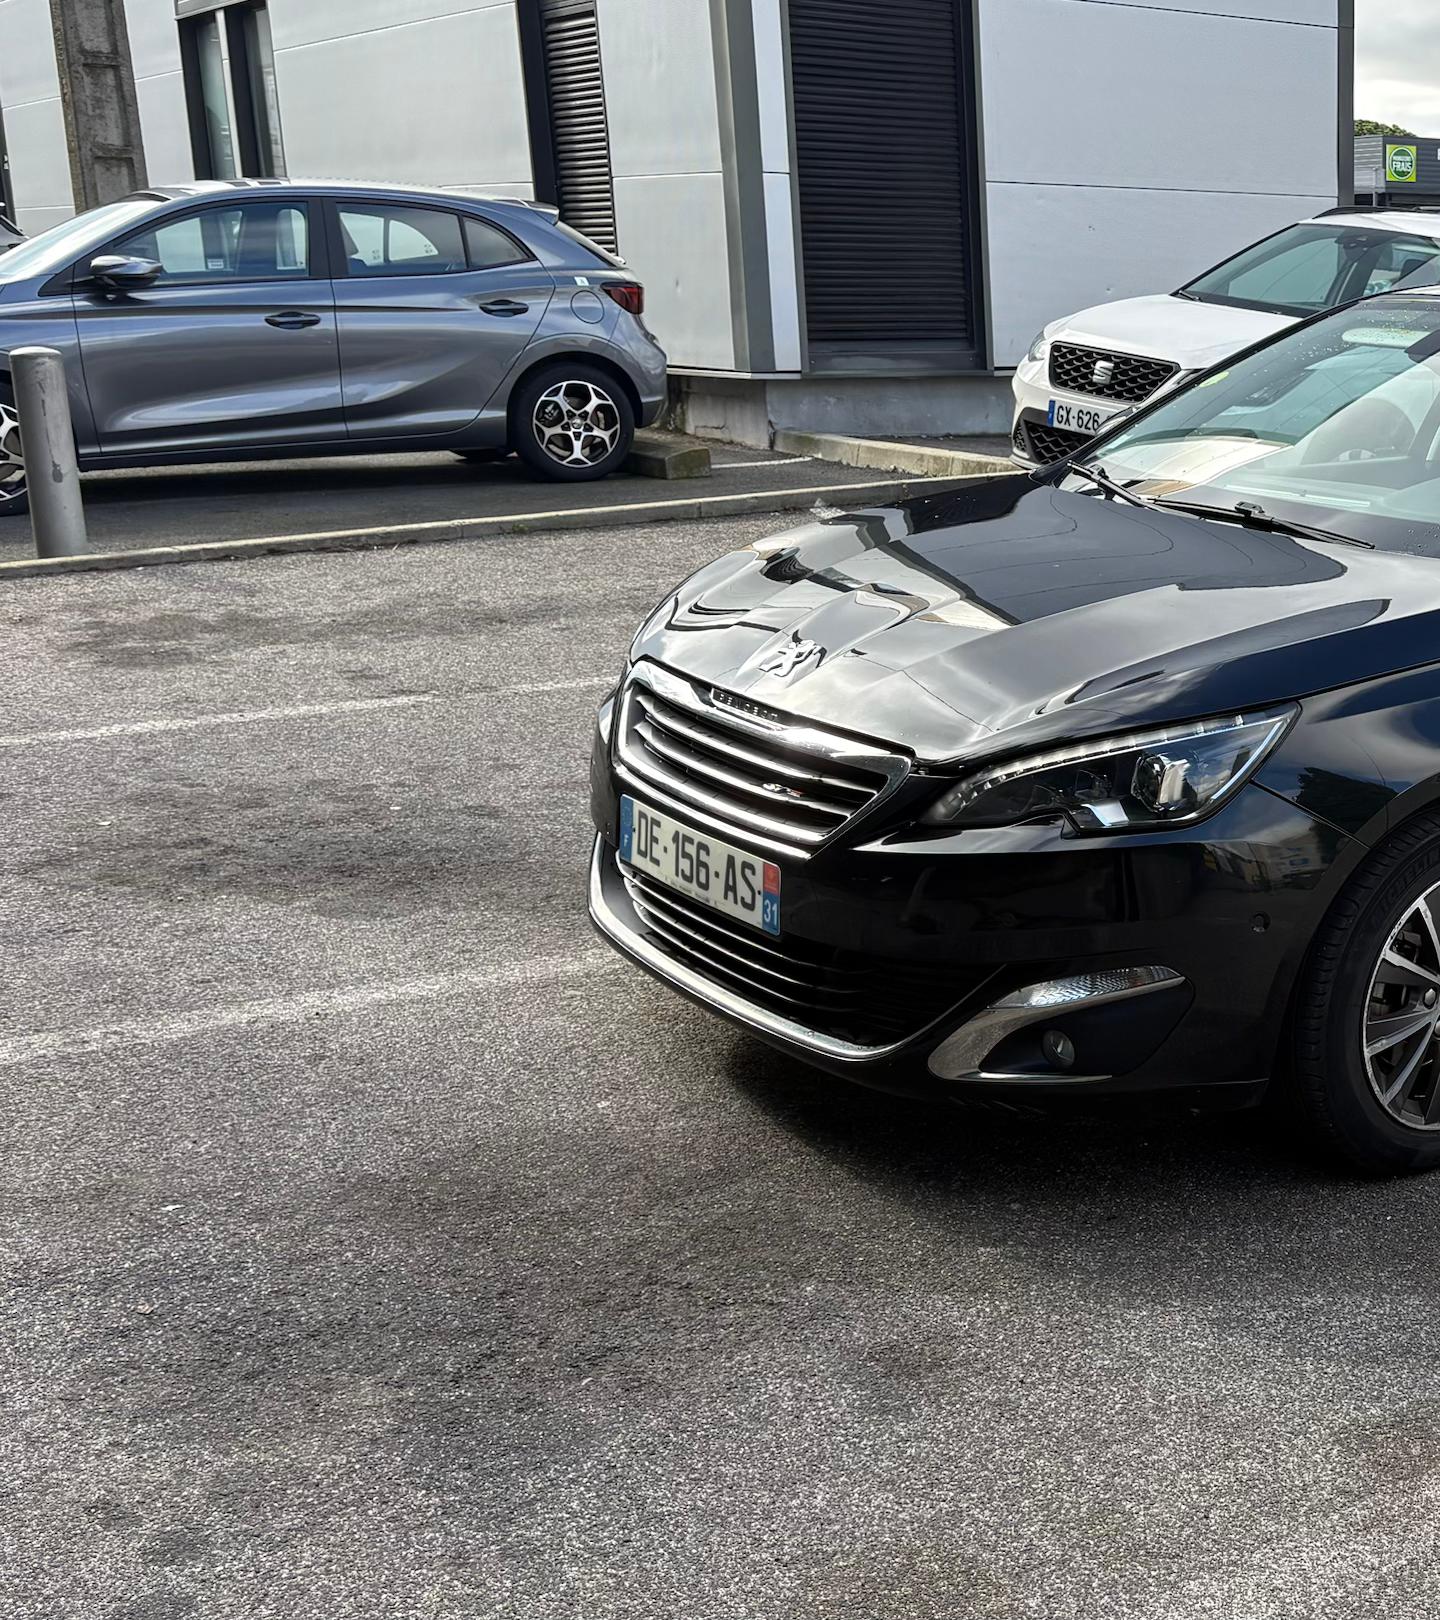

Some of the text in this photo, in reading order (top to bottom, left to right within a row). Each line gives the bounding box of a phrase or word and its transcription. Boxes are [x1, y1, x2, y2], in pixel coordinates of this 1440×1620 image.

[1056, 405, 1106, 432] GX-626
[637, 810, 756, 911] DE-156-AS
[763, 899, 778, 926] 31
